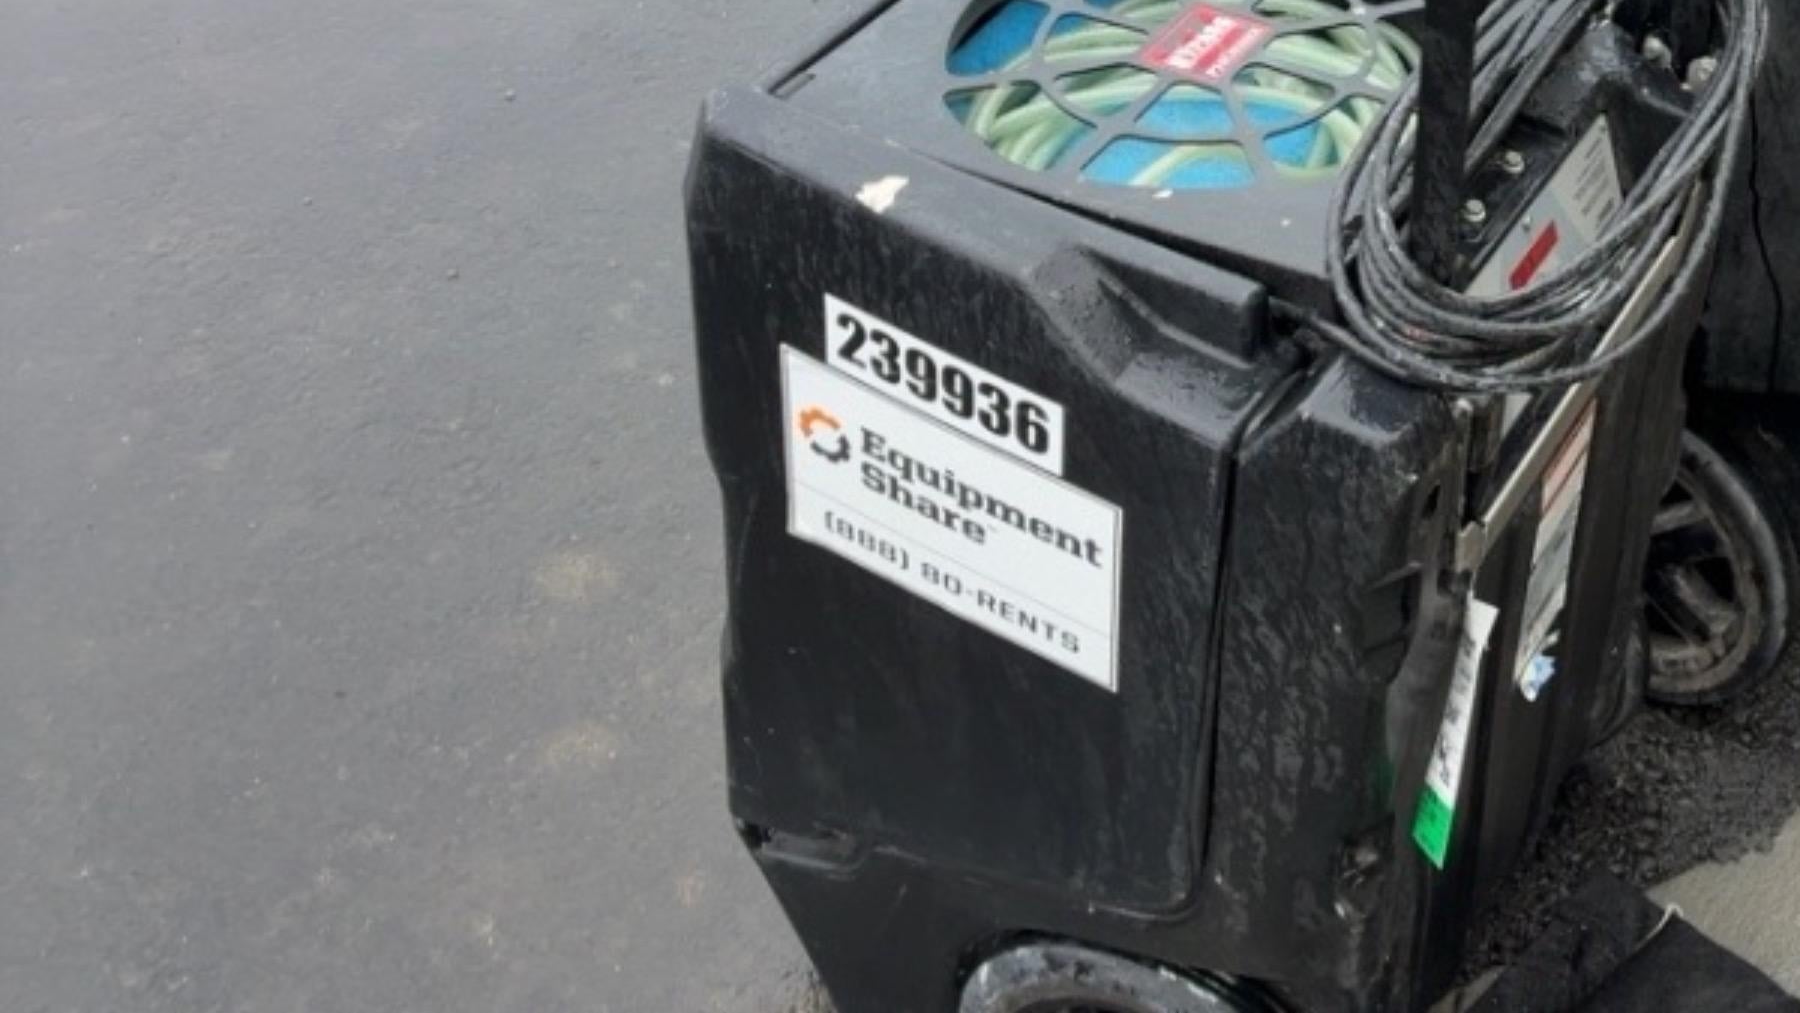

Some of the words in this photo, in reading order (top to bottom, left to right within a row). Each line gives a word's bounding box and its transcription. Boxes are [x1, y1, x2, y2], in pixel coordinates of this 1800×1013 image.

[836, 312, 1049, 456] 239936
[860, 425, 1104, 570] Equipment
[860, 463, 986, 545] Share
[823, 509, 911, 572] (888)
[920, 561, 1082, 655] 80-RENTS
